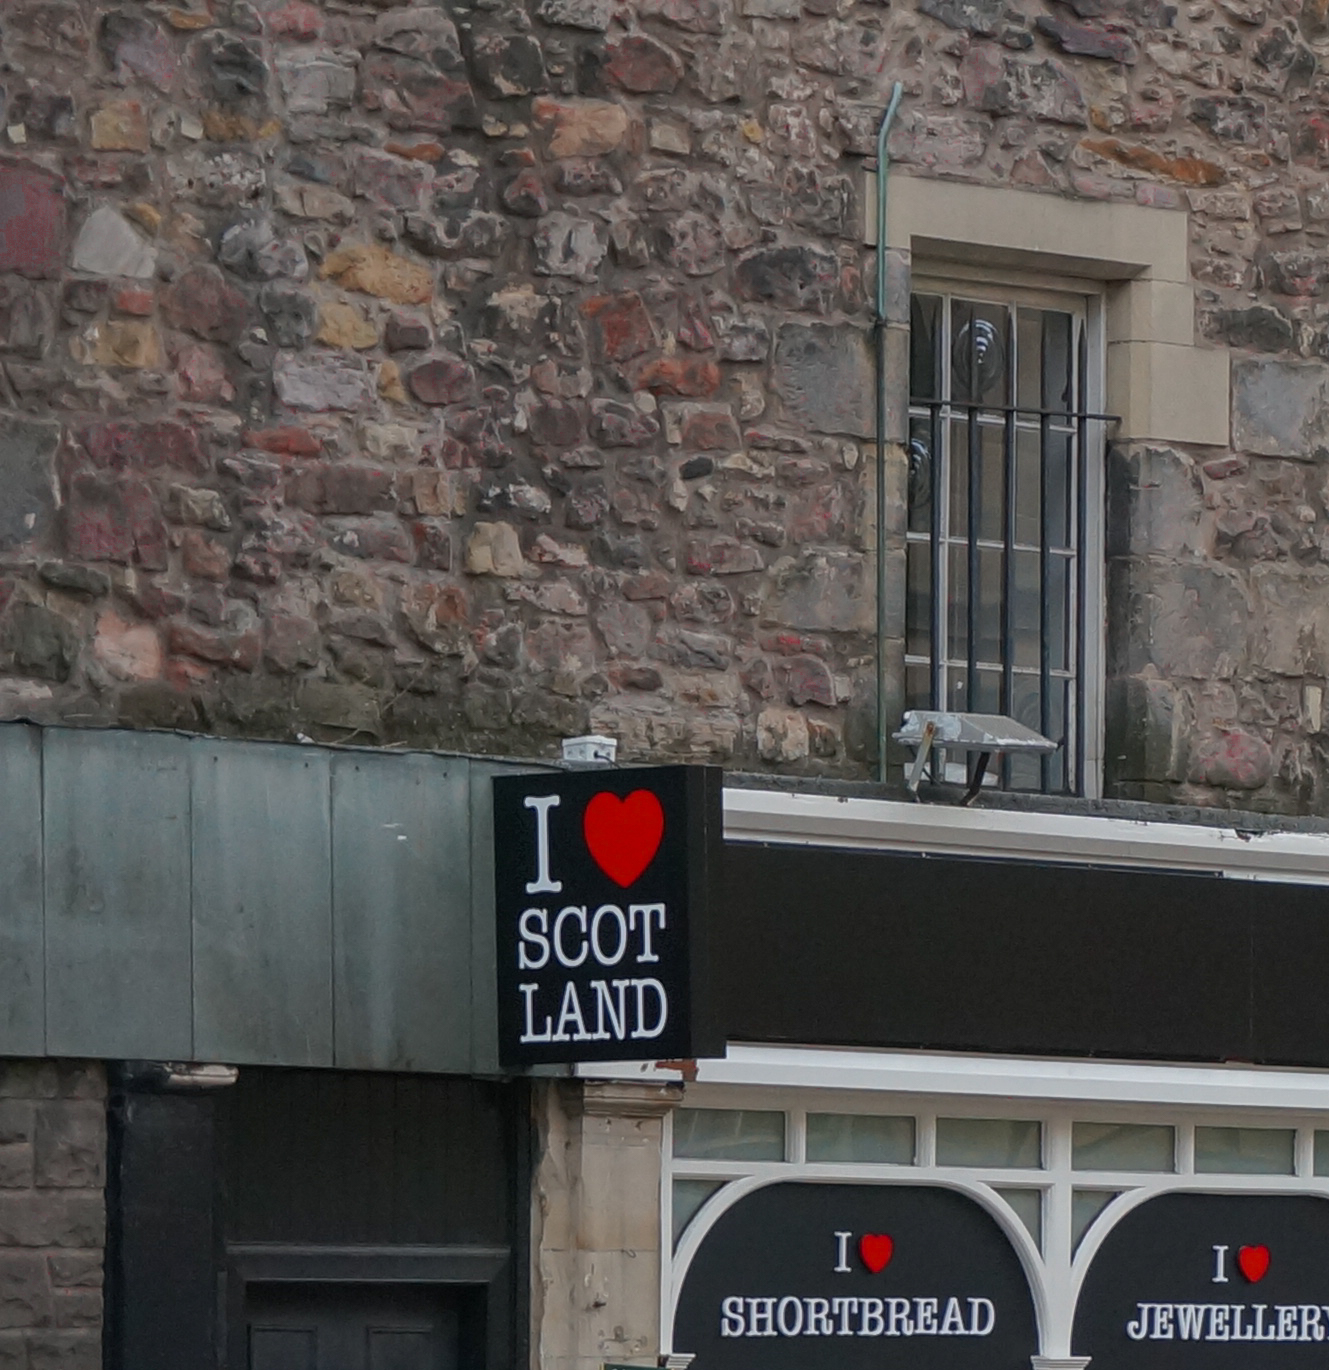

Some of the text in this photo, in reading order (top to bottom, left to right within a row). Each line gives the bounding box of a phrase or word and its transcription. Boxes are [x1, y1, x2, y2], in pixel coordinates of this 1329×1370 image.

[524, 795, 562, 893] I
[518, 903, 666, 970] SCOT
[519, 977, 668, 1043] LAND
[834, 1231, 852, 1273] I
[1212, 1245, 1230, 1283] I
[721, 1297, 995, 1337] SHORTBREAD
